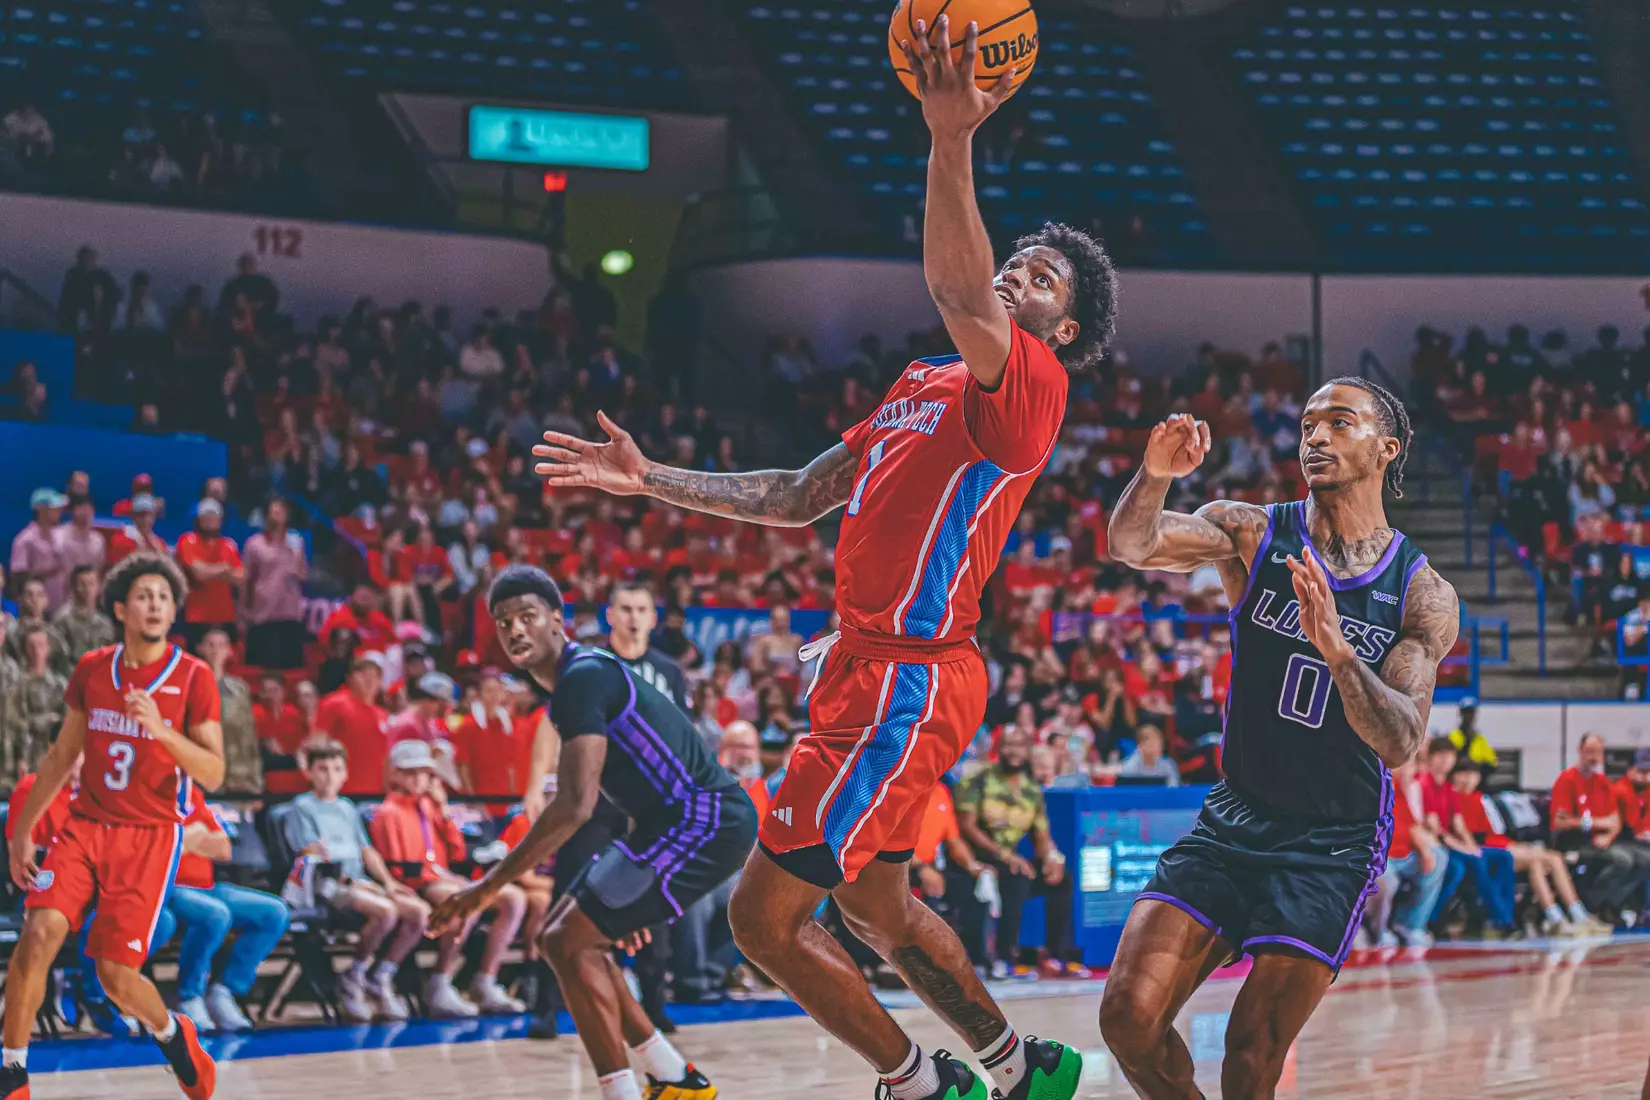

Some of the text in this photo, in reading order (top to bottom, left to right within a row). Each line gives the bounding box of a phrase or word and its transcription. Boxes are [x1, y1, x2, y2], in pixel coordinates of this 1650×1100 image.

[254, 225, 303, 258] 112
[848, 439, 886, 516] 1
[1252, 588, 1396, 663] LOES
[1372, 590, 1399, 605] WAC
[1278, 653, 1333, 729] 0
[104, 740, 135, 790] 3
